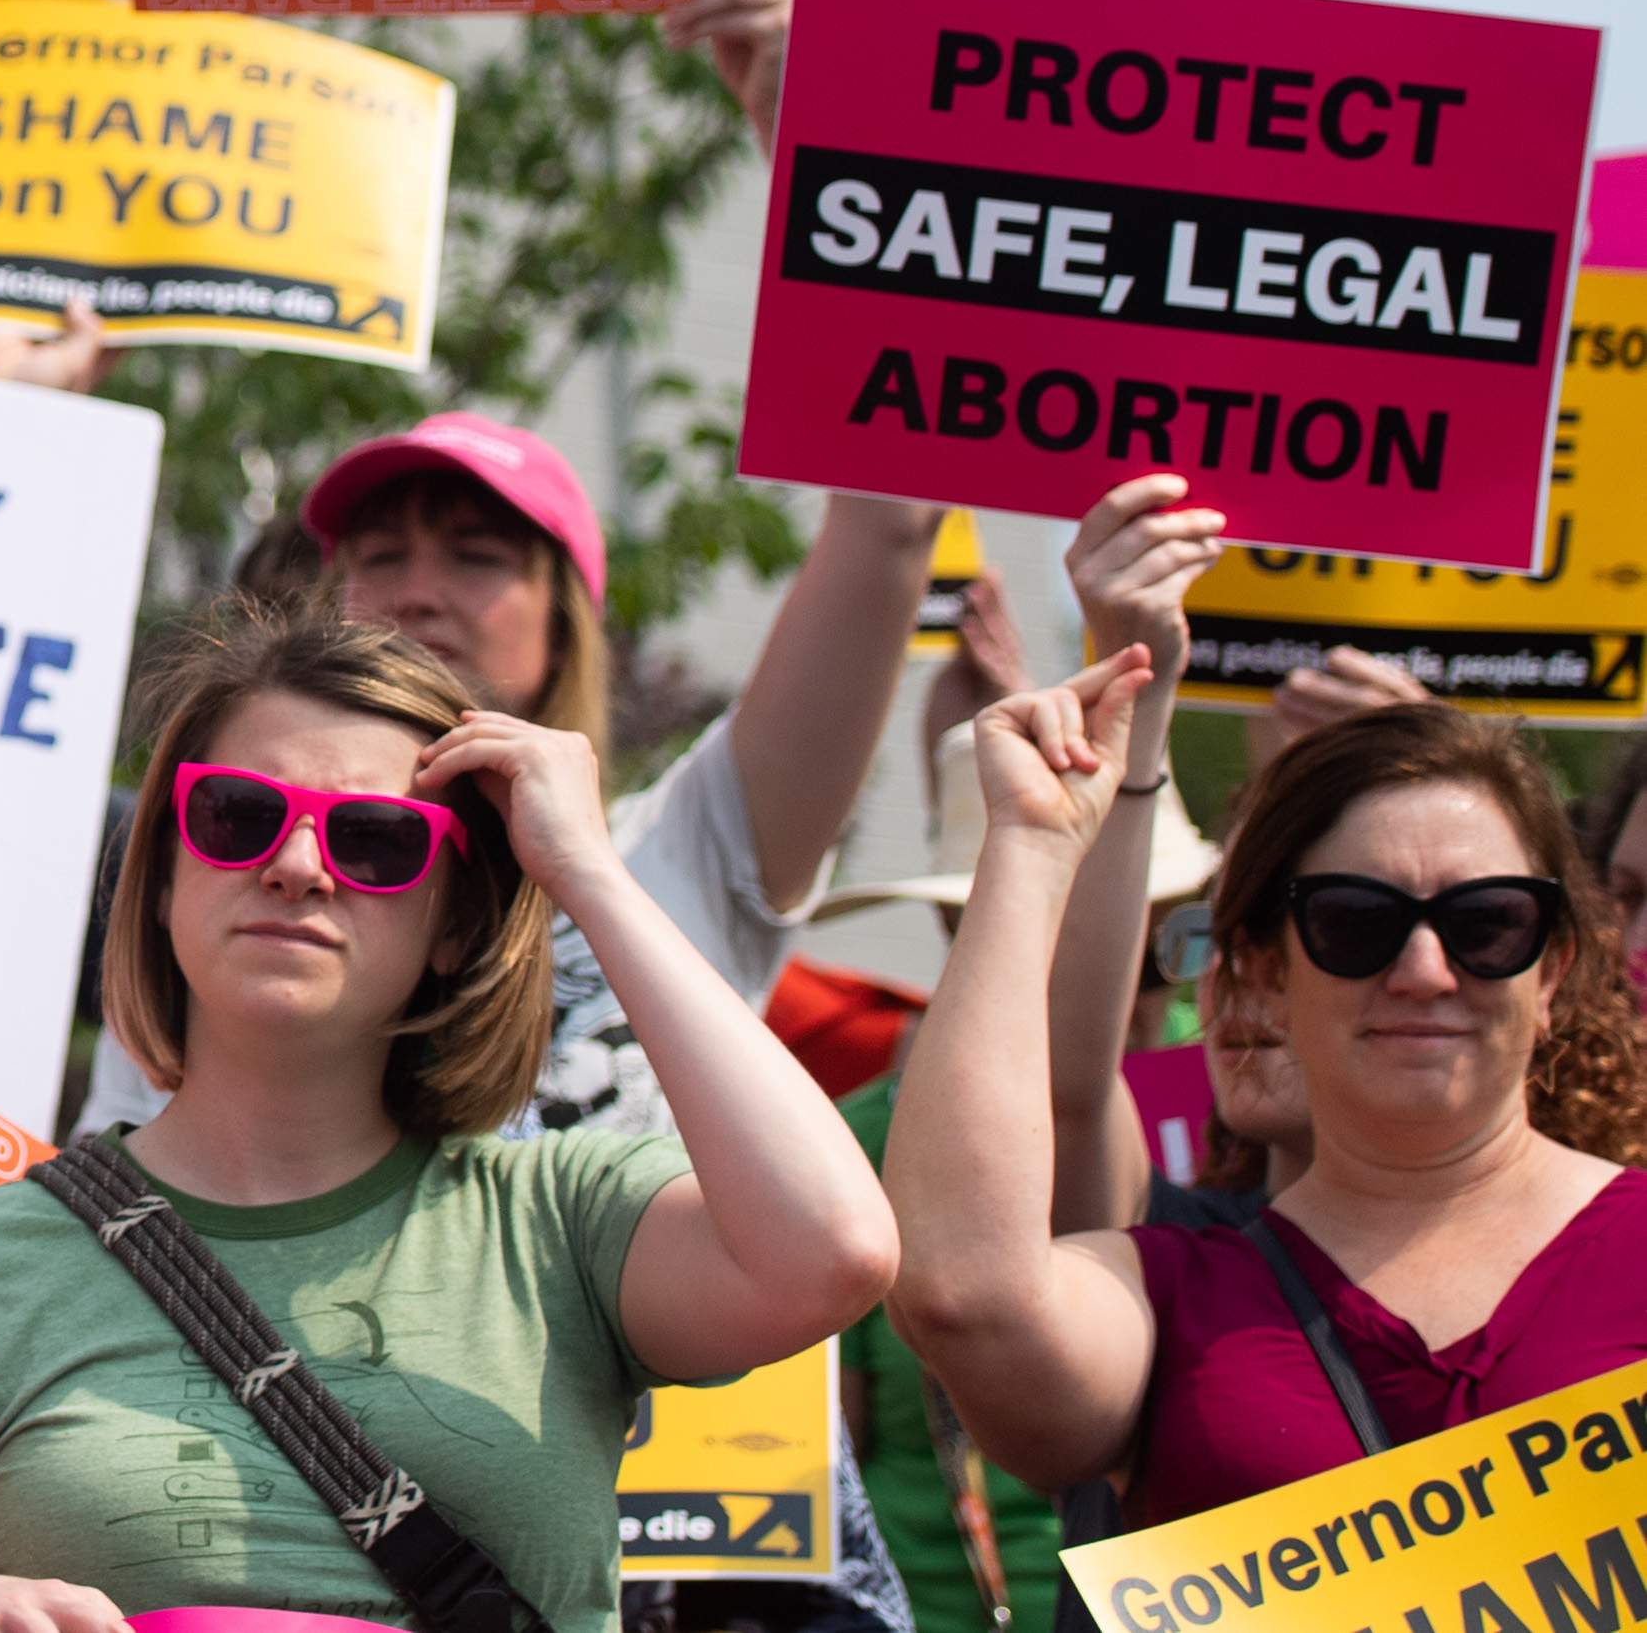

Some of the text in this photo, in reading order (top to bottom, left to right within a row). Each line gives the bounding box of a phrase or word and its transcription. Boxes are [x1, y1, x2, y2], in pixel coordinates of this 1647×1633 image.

[928, 28, 1466, 168] PROTECT
[100, 167, 295, 240] YOU
[809, 178, 1521, 343] SAFE, LEGAL
[151, 276, 273, 319] people
[271, 286, 335, 324] die
[847, 347, 1450, 493] ABORTION
[1110, 1456, 1495, 1633] Governor
